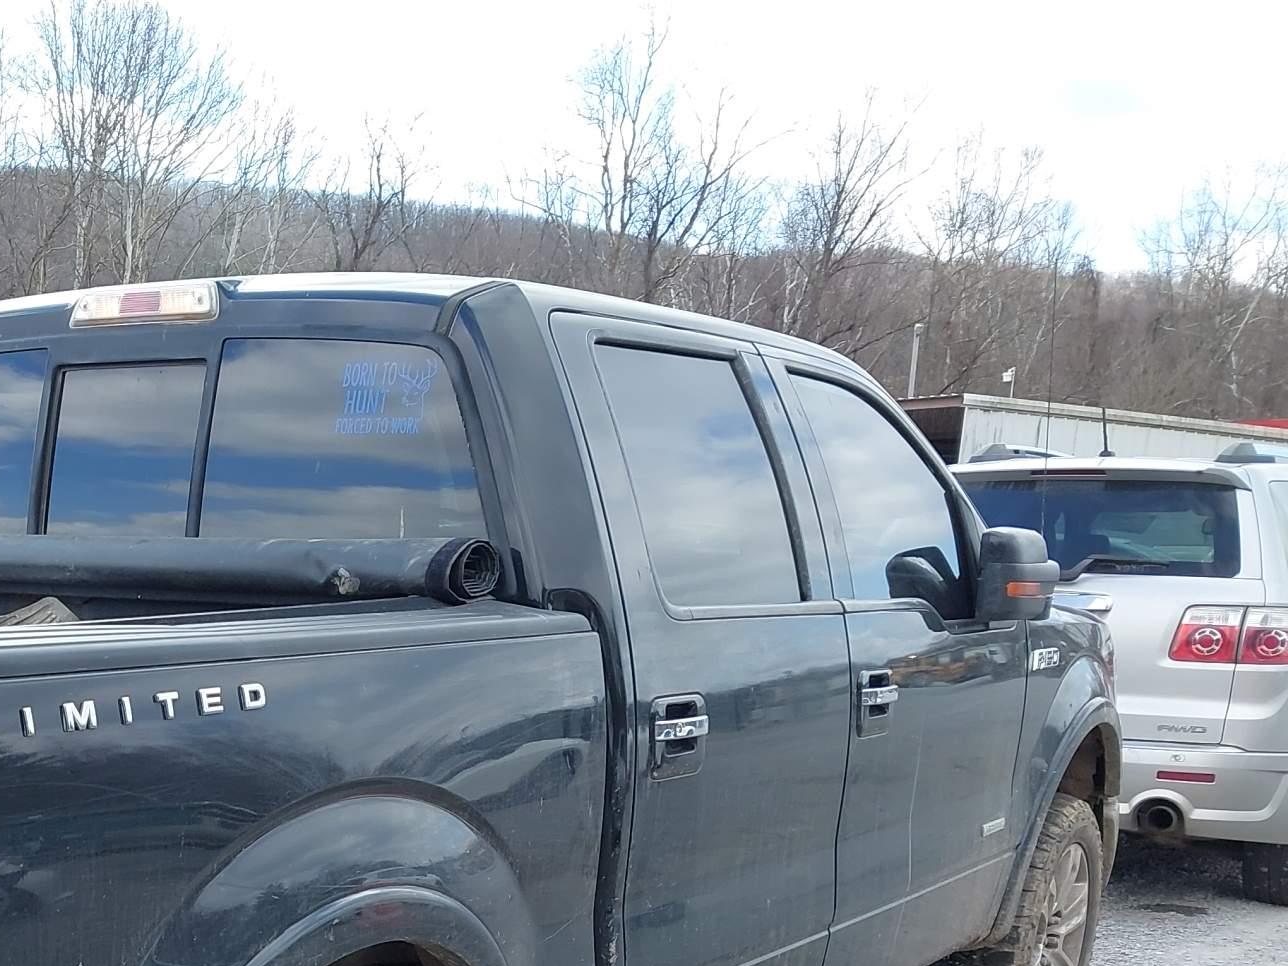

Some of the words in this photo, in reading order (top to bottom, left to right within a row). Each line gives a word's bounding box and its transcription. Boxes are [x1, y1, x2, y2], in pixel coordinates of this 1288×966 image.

[343, 362, 377, 387] BORN
[382, 361, 398, 386] TO
[344, 389, 390, 415] HUNT
[335, 418, 372, 434] FORCED
[376, 417, 389, 434] TO
[391, 416, 419, 434] WORK
[1157, 724, 1208, 734] AWD
